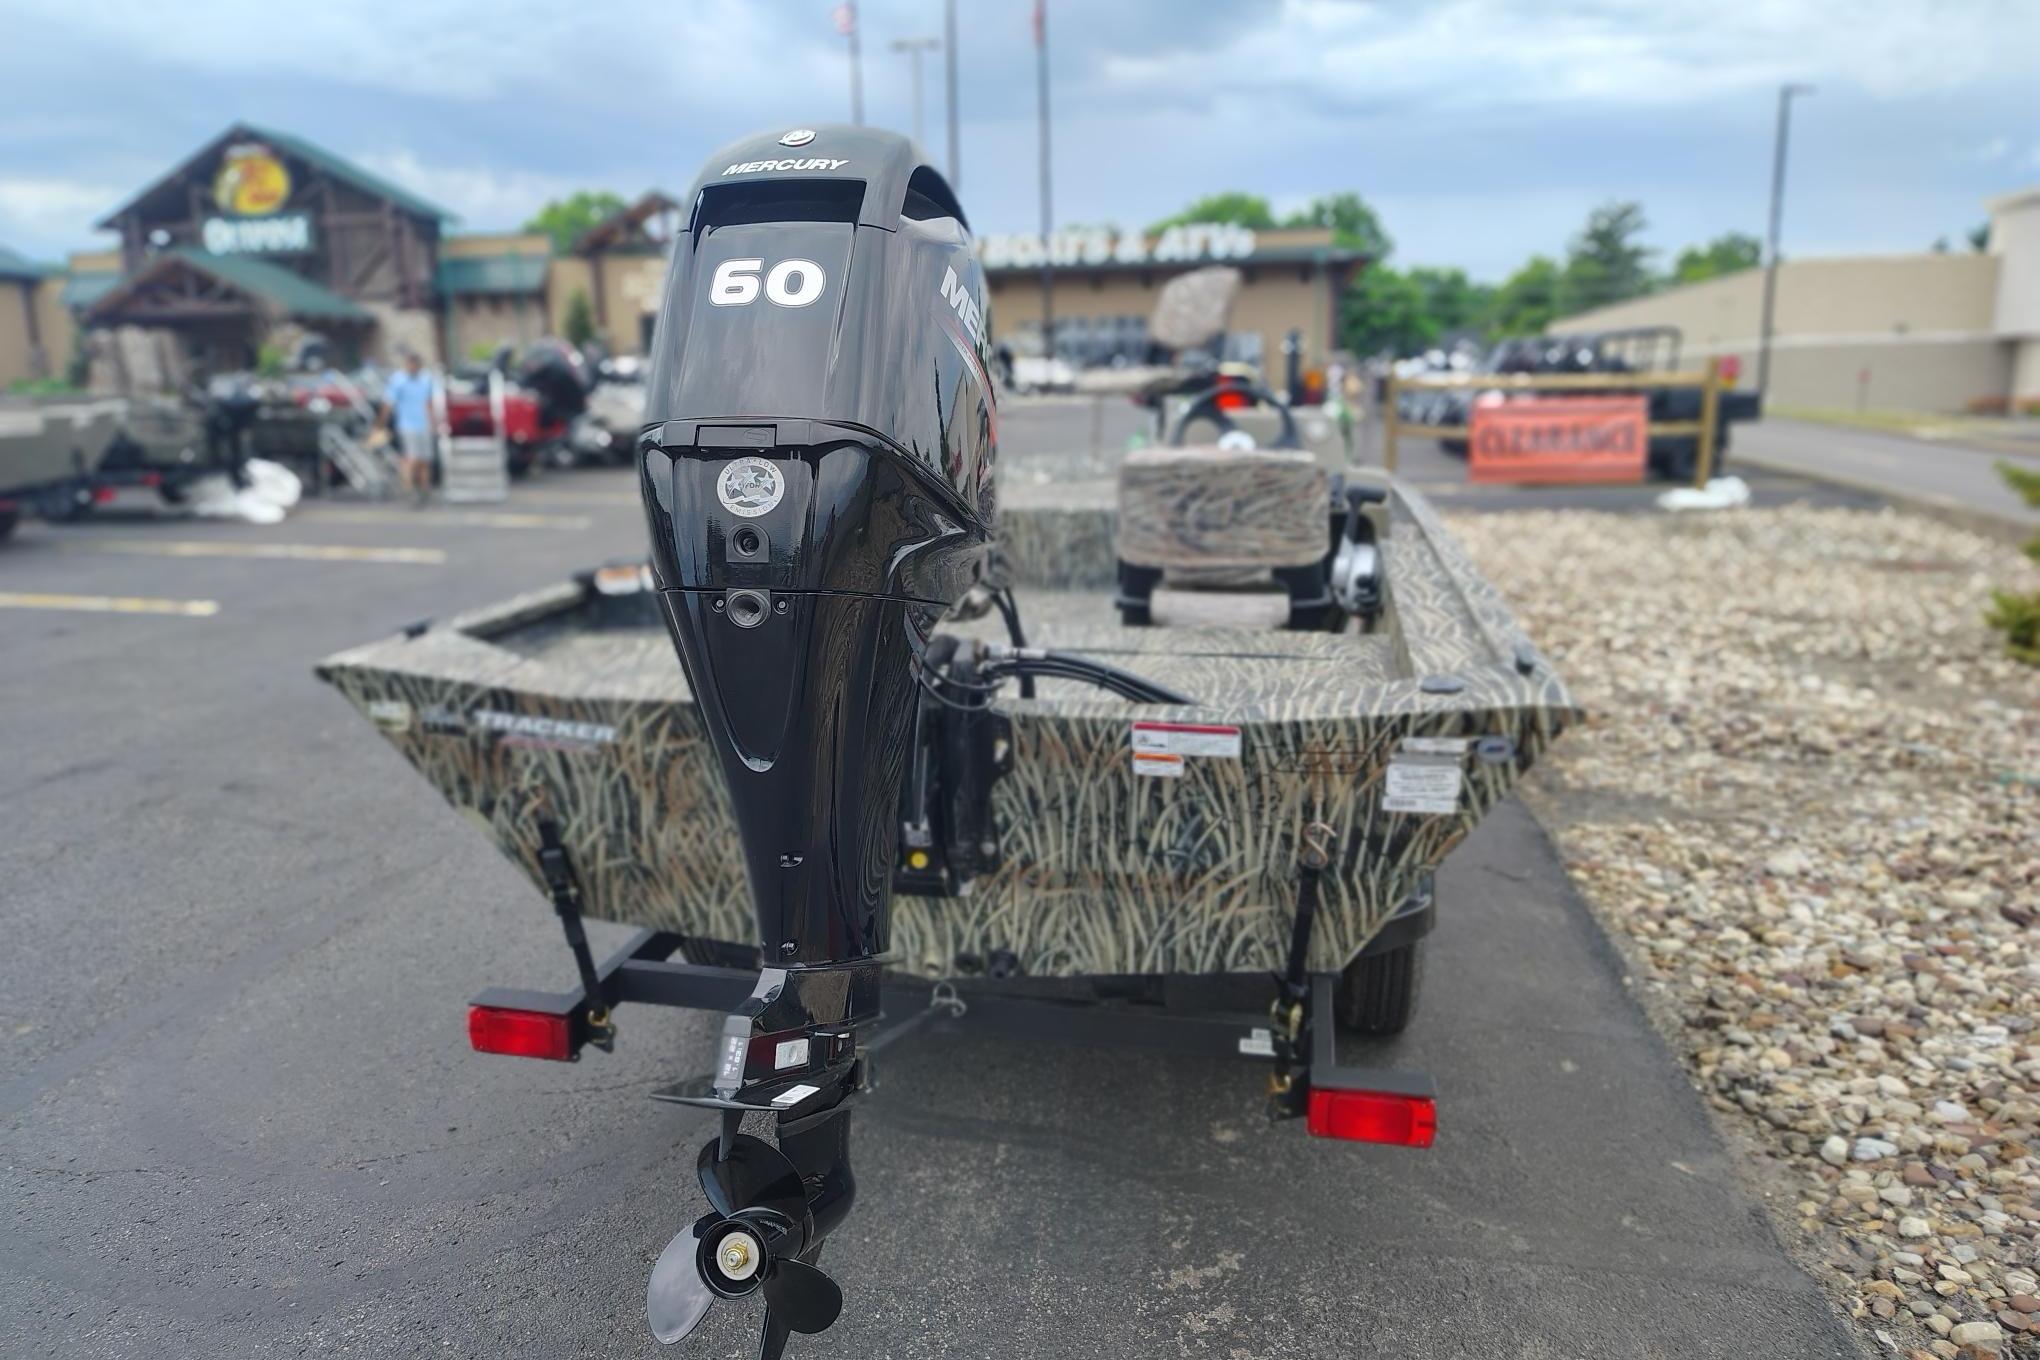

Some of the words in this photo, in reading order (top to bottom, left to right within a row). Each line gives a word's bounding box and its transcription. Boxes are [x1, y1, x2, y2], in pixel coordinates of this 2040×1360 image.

[722, 158, 849, 176] MERCURY
[708, 257, 827, 309] 60
[473, 709, 617, 742] TRACKER
